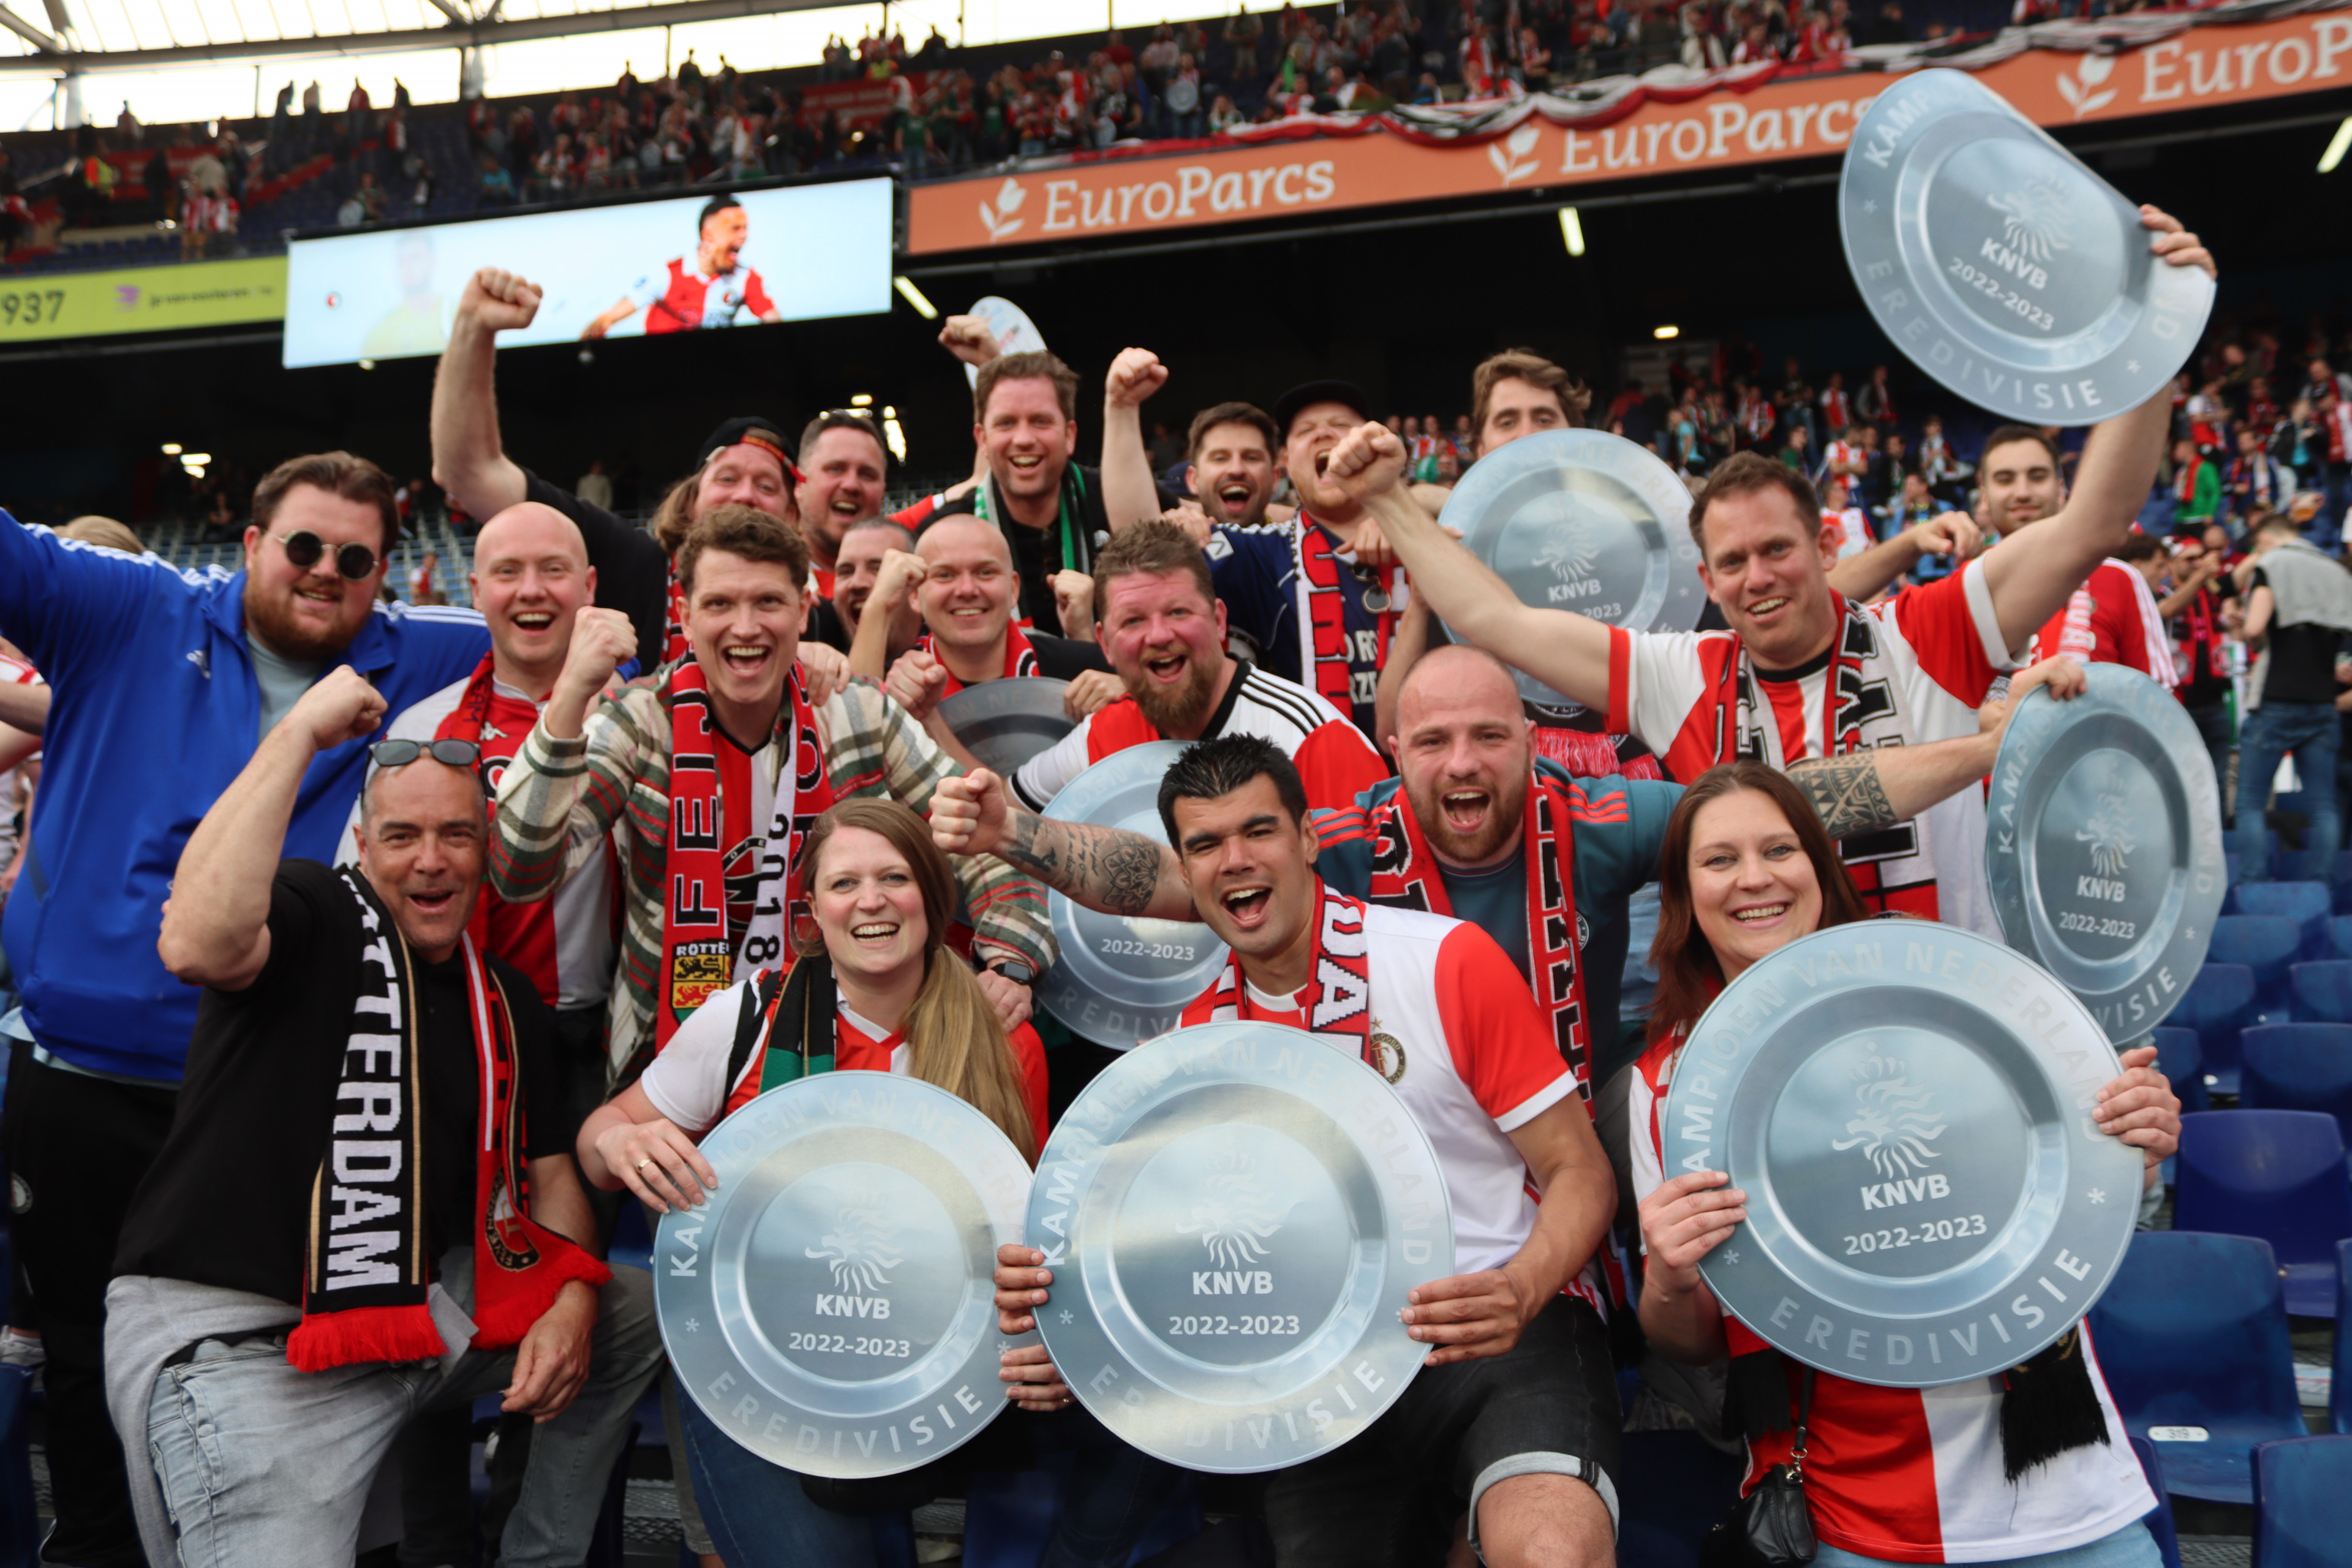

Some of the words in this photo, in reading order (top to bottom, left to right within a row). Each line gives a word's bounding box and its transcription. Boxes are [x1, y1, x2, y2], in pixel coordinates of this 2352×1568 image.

[1042, 160, 1335, 231] EuroParcs
[1980, 238, 2049, 290] KNVB
[1948, 257, 2055, 331] 2022-2023
[1867, 260, 2101, 409] EREDIVISIE
[1548, 579, 1602, 603] KNVB
[744, 813, 790, 966] 2018
[2076, 875, 2126, 903] KNVB
[2059, 912, 2136, 939] 2022-2023
[676, 941, 729, 957] ROTTE
[1101, 938, 1195, 962] 2022-2023
[2096, 966, 2177, 1030] VISIE
[1682, 980, 1785, 1174] AMPIOEN
[1792, 941, 1884, 989] VAN
[818, 1087, 898, 1116] VAN
[1039, 1065, 1166, 1267] KAMPIOEN
[1172, 1040, 1257, 1077] VAN
[1273, 1047, 1433, 1265] NEDERLAND
[1860, 1174, 1950, 1211] KNVB
[1844, 1214, 1988, 1256] 2022-2023
[1193, 1271, 1273, 1295] KNVB
[815, 1294, 890, 1319] KNVB
[1169, 1315, 1300, 1336] 2022-2023
[1768, 1248, 2093, 1366] EREDIVISIE
[788, 1332, 911, 1358] 2022-2023
[706, 1371, 983, 1458] EREDIVISIE
